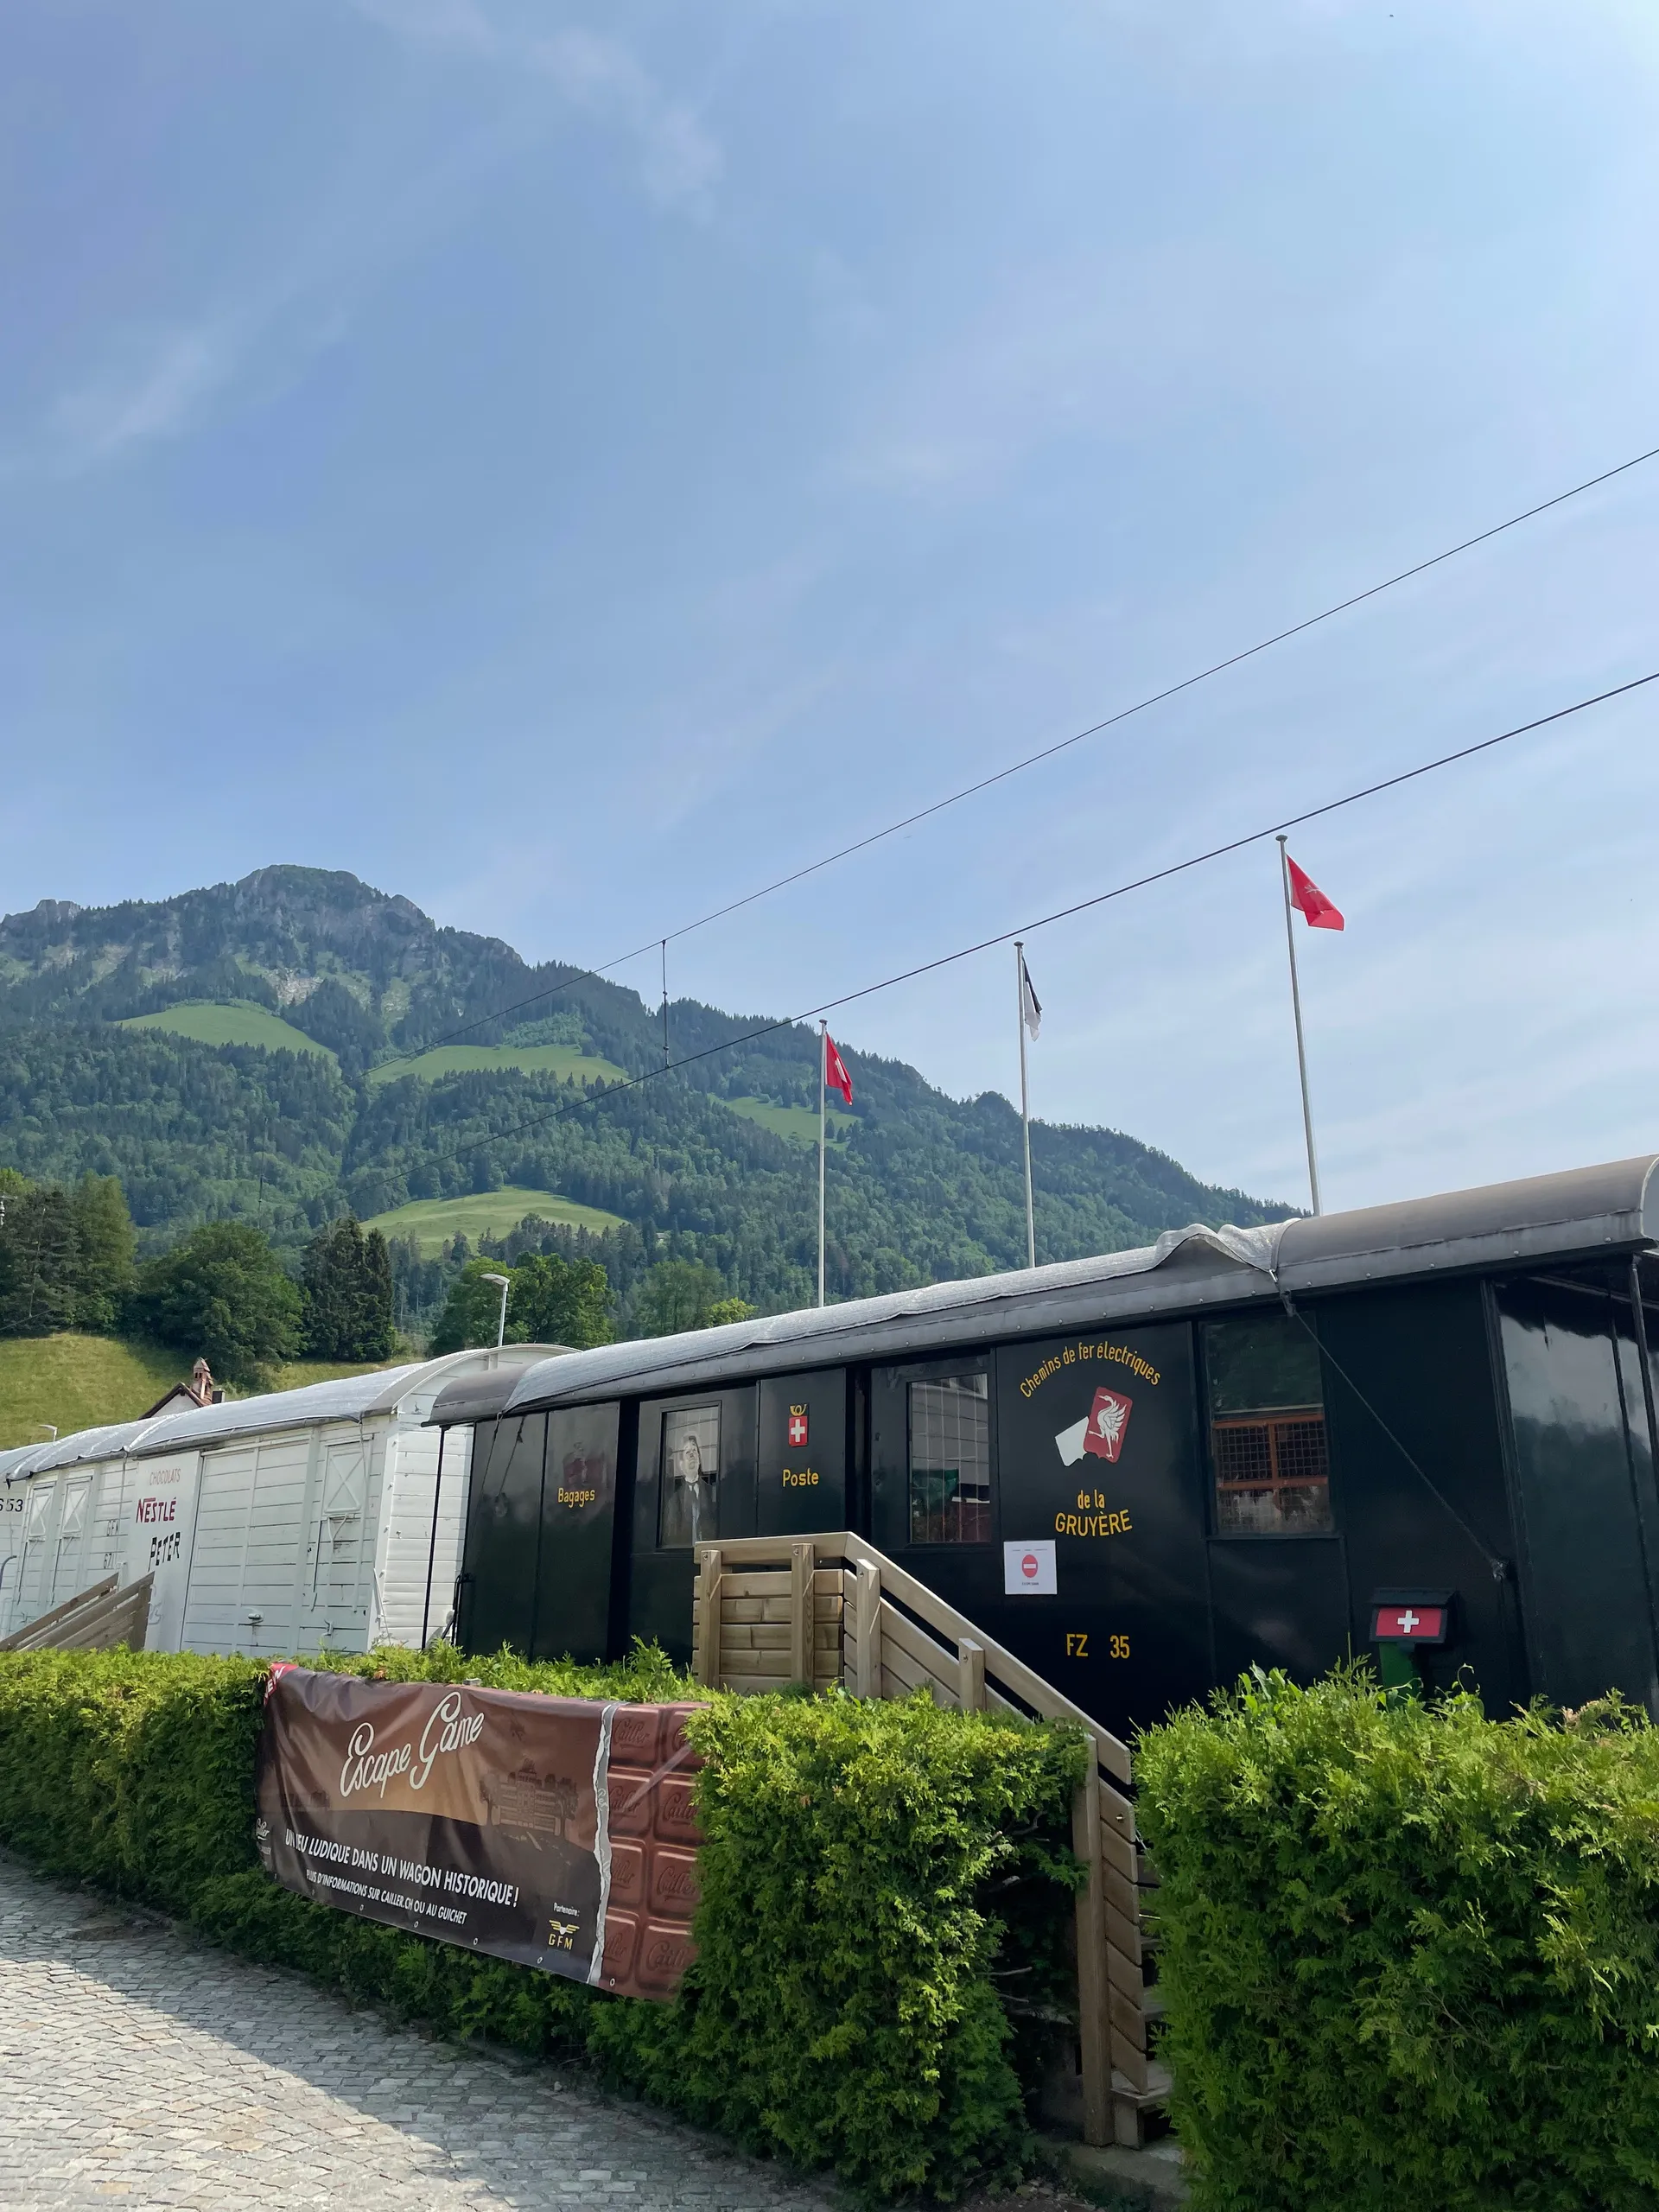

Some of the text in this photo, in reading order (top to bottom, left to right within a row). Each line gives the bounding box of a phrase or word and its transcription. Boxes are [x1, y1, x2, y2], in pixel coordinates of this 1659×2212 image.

[1020, 1341, 1160, 1398] Chemins de fer électriques
[149, 1468, 181, 1486] CHOCOLATS
[782, 1468, 819, 1487] Poste
[136, 1497, 177, 1523] NESTLÉ
[557, 1487, 595, 1509] Bagages
[1077, 1489, 1105, 1510] de la
[1055, 1509, 1133, 1536] GRUYÈRE
[148, 1531, 181, 1573] PETER
[1067, 1634, 1130, 1659] FZ 35
[613, 1717, 650, 1745] Cailler
[340, 1691, 485, 1798] Escape Game
[285, 1828, 296, 1848] UN
[308, 1837, 351, 1865] LUDIQUE
[352, 1847, 378, 1872] DANS
[381, 1855, 397, 1877] UN
[399, 1859, 442, 1889] WAGON
[306, 1869, 467, 1925] PLUS D'INFORMATIONS SUR CAILLER.CH OU AU GUICHET
[549, 1933, 573, 1950] GFM
